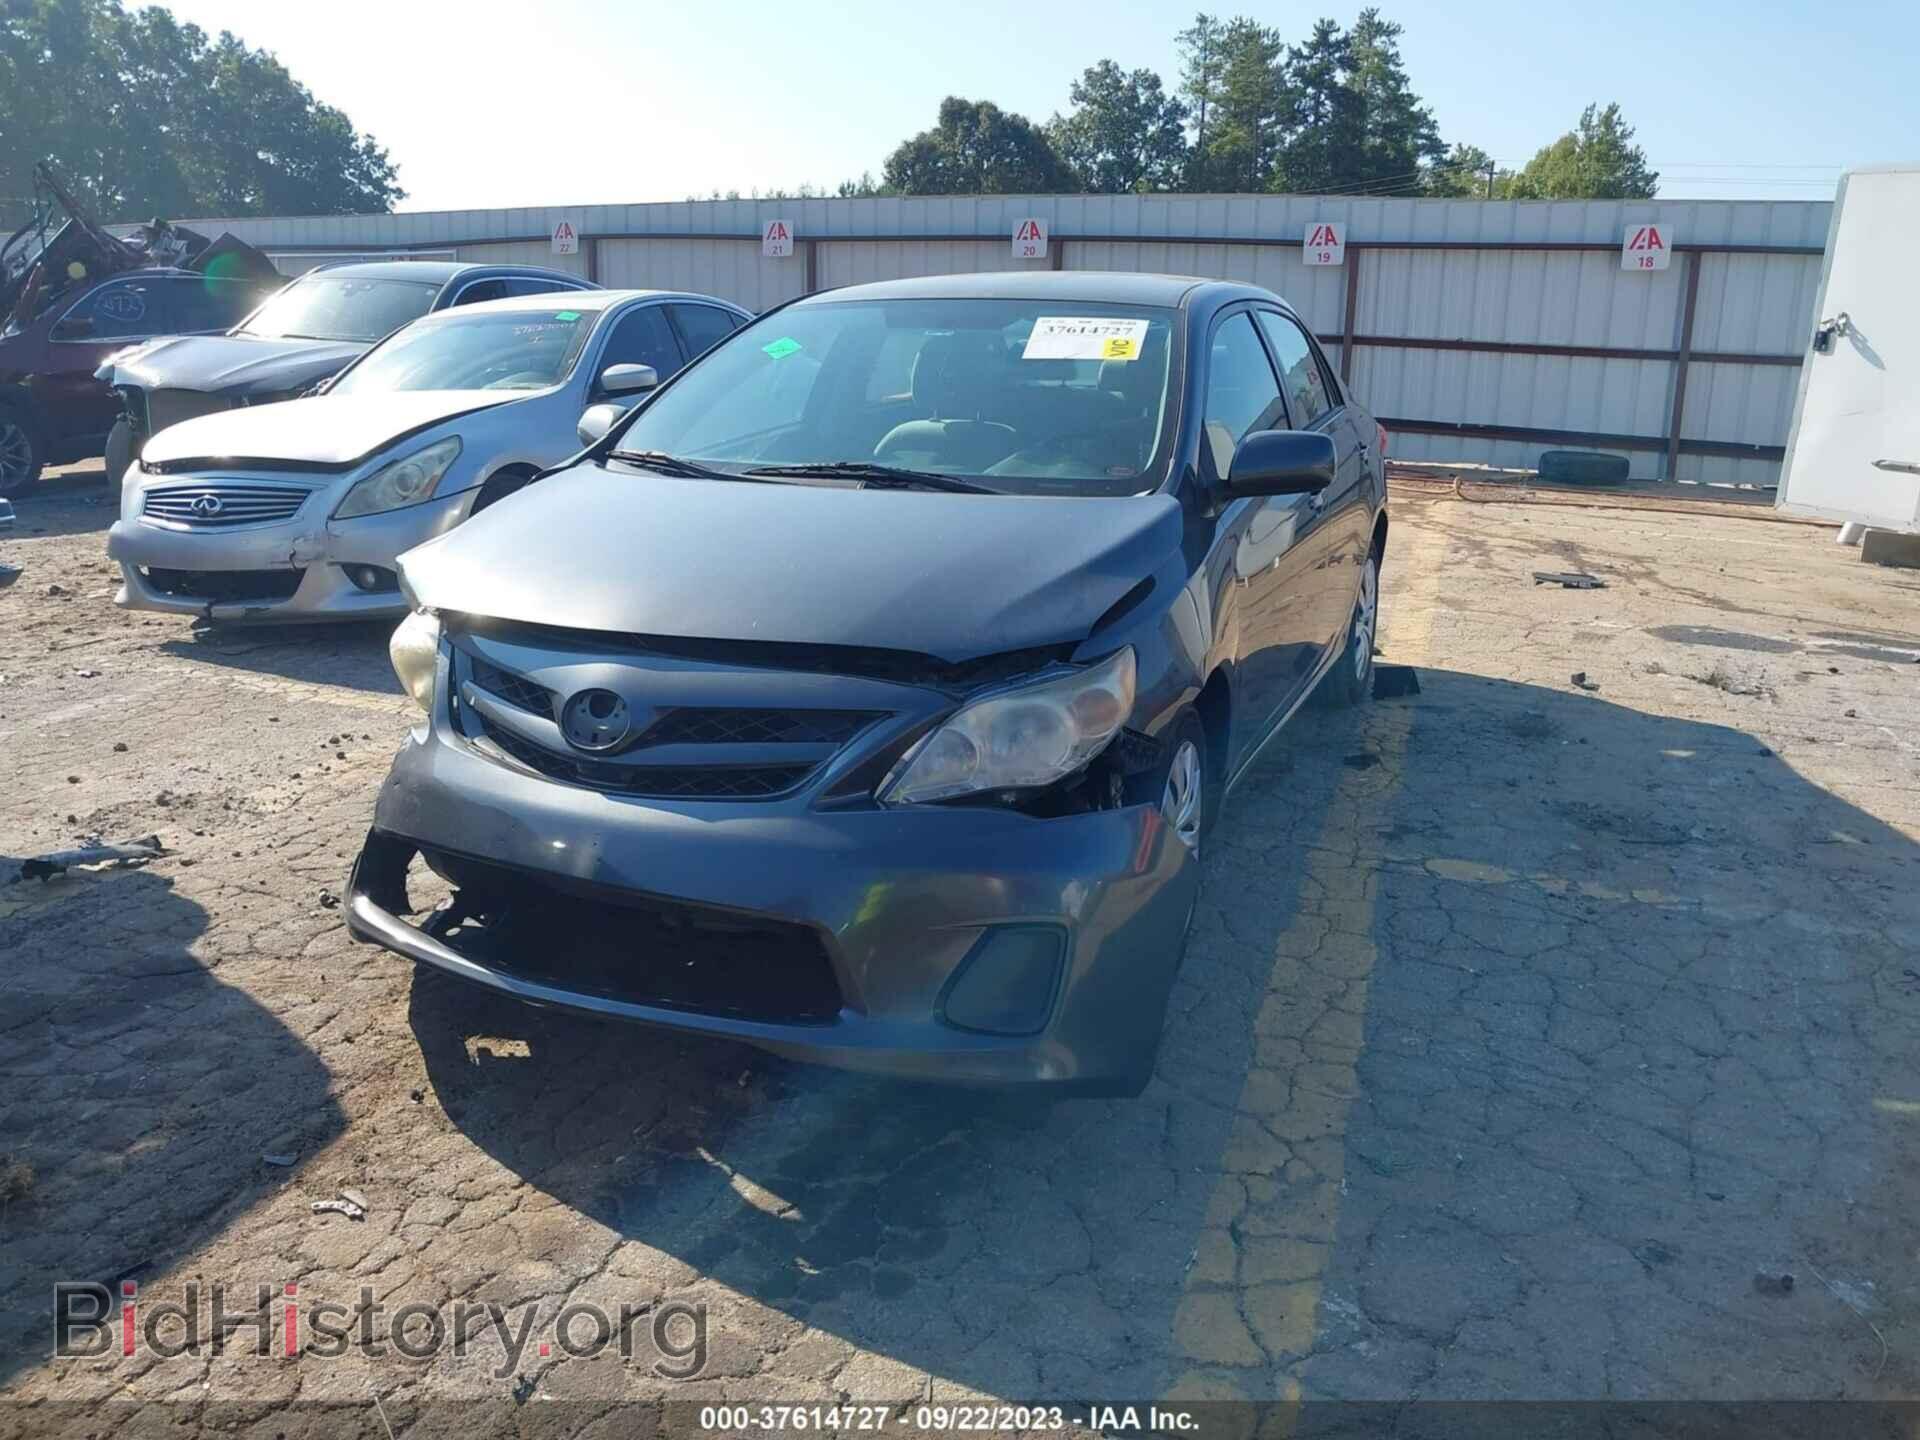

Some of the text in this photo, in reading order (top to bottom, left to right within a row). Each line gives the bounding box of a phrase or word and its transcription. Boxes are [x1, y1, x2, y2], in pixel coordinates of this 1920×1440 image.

[1023, 246, 1036, 256] 20
[1317, 252, 1330, 262] 19
[1638, 256, 1654, 268] 18
[1044, 326, 1133, 335] 37614727
